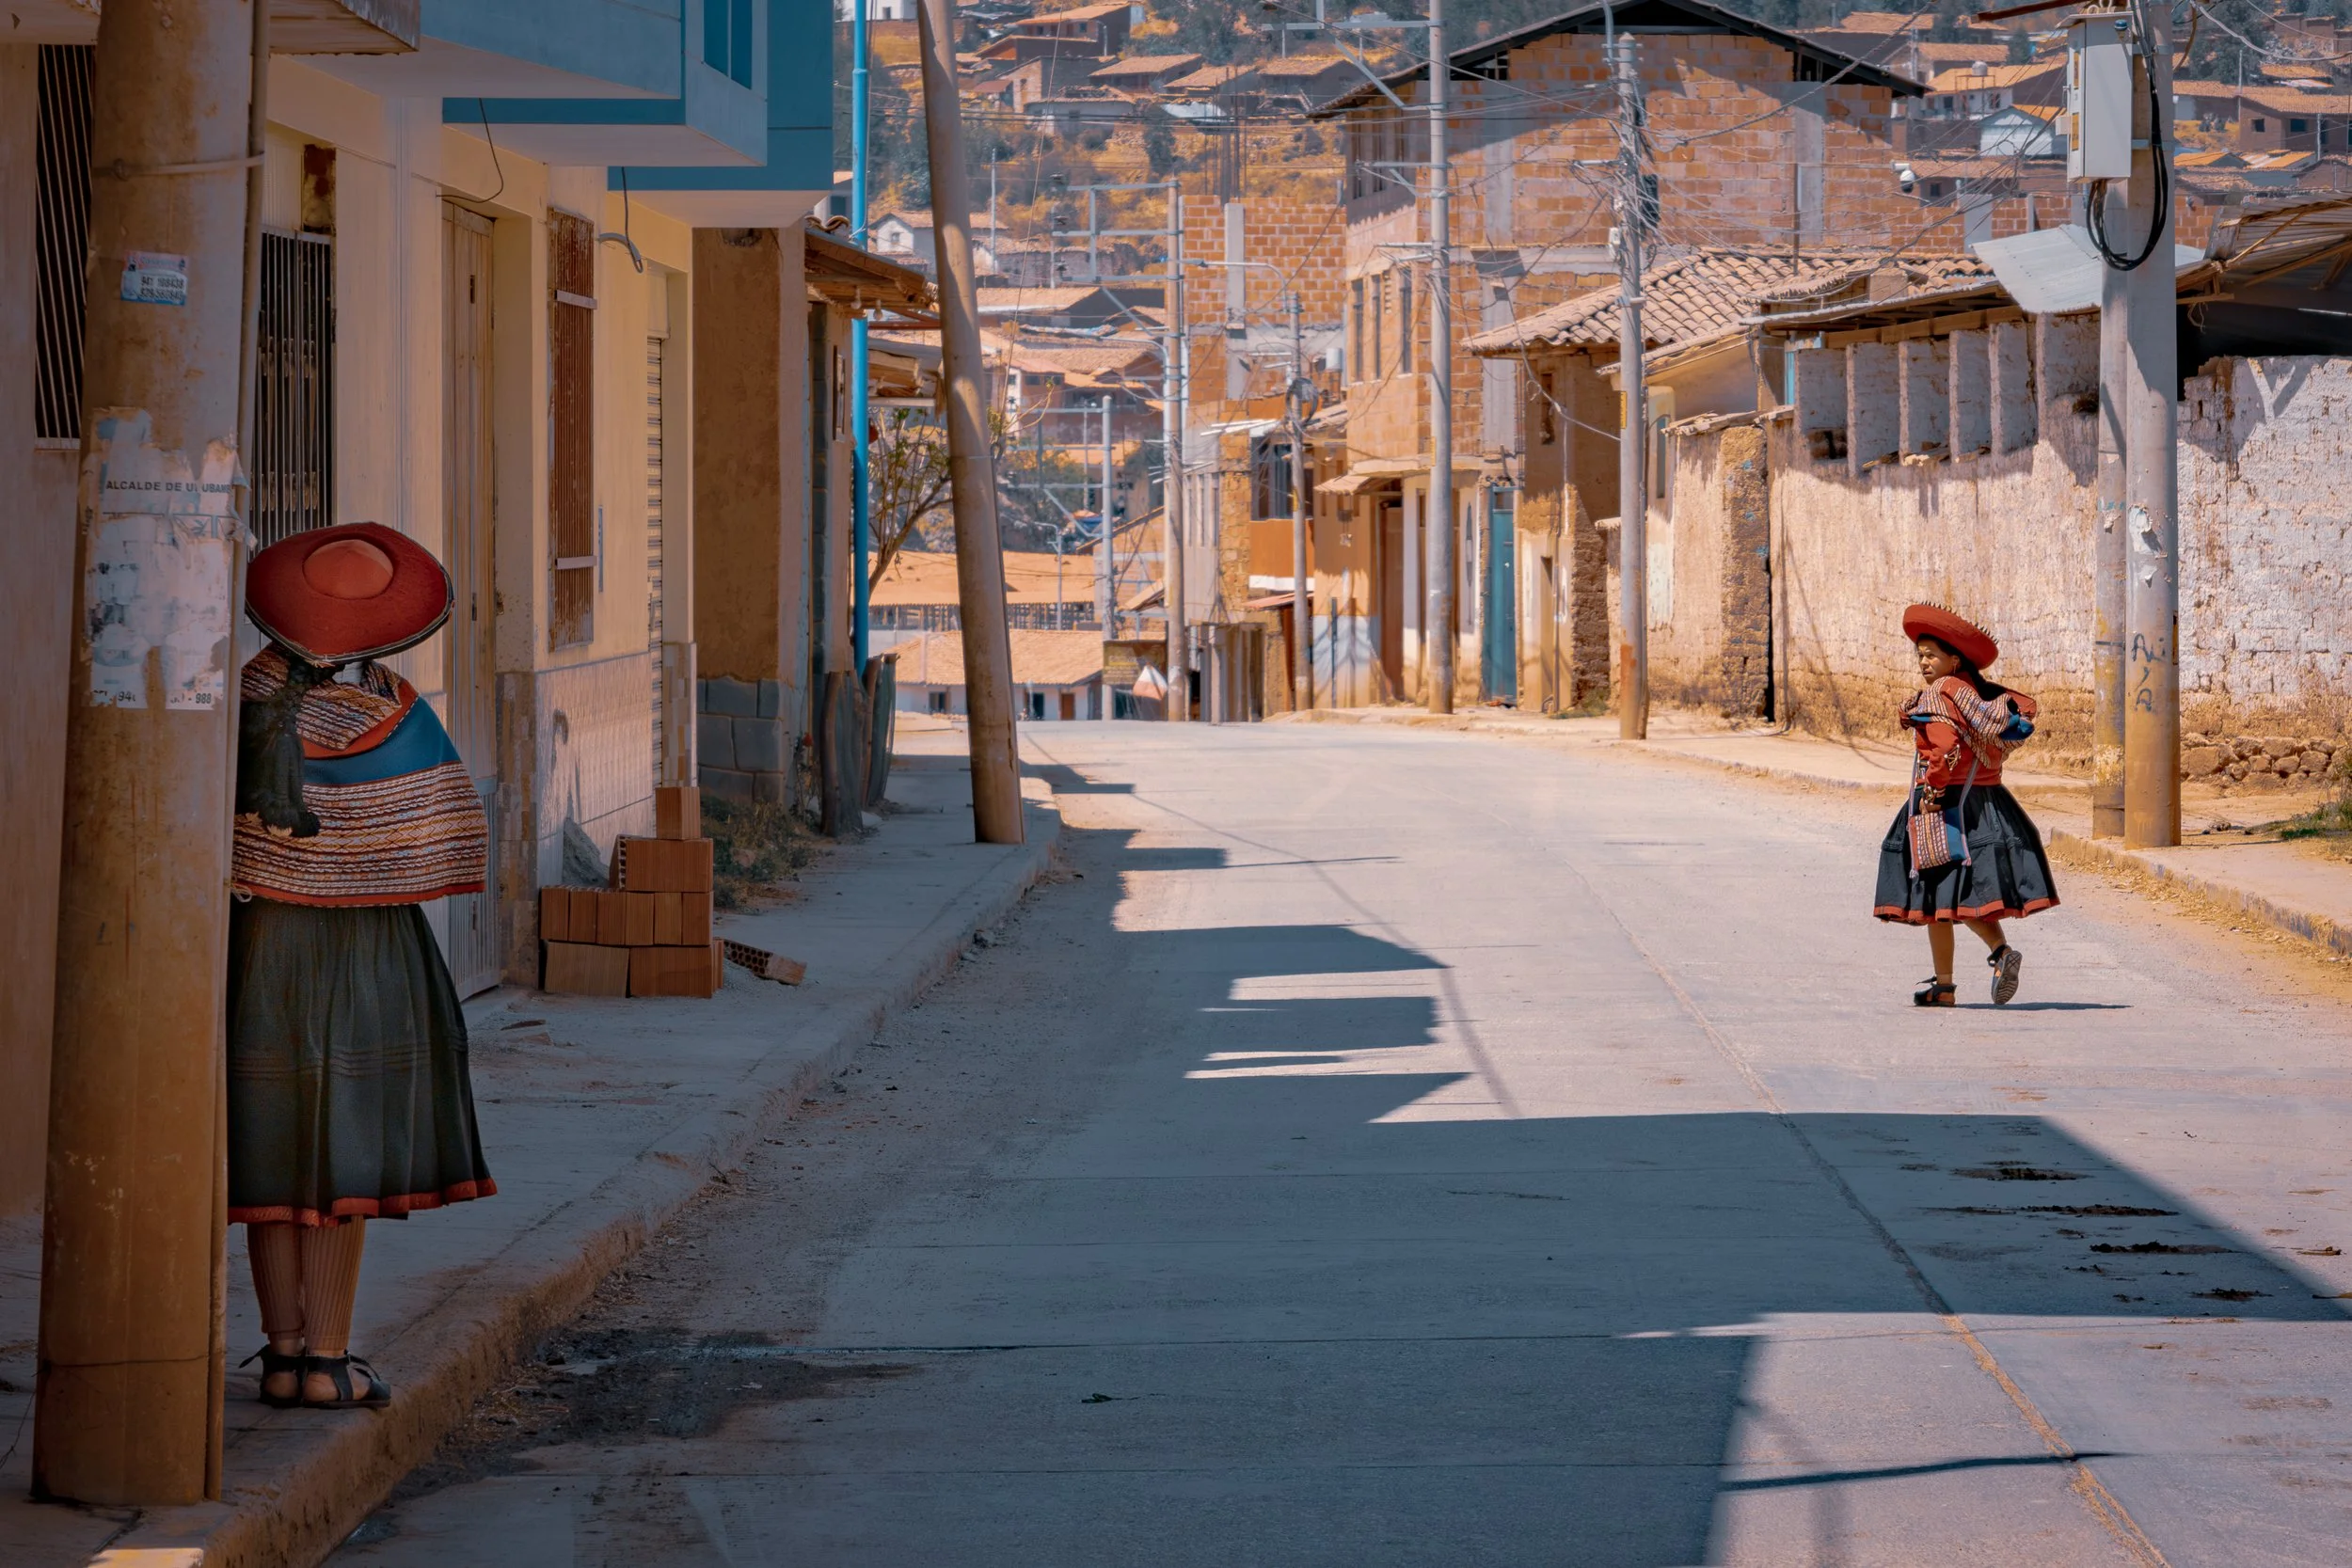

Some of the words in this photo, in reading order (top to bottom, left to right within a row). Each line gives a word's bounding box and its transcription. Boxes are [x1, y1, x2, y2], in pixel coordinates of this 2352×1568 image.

[105, 481, 162, 491] ALCALDE
[165, 482, 183, 492] DE
[195, 692, 212, 705] 988
